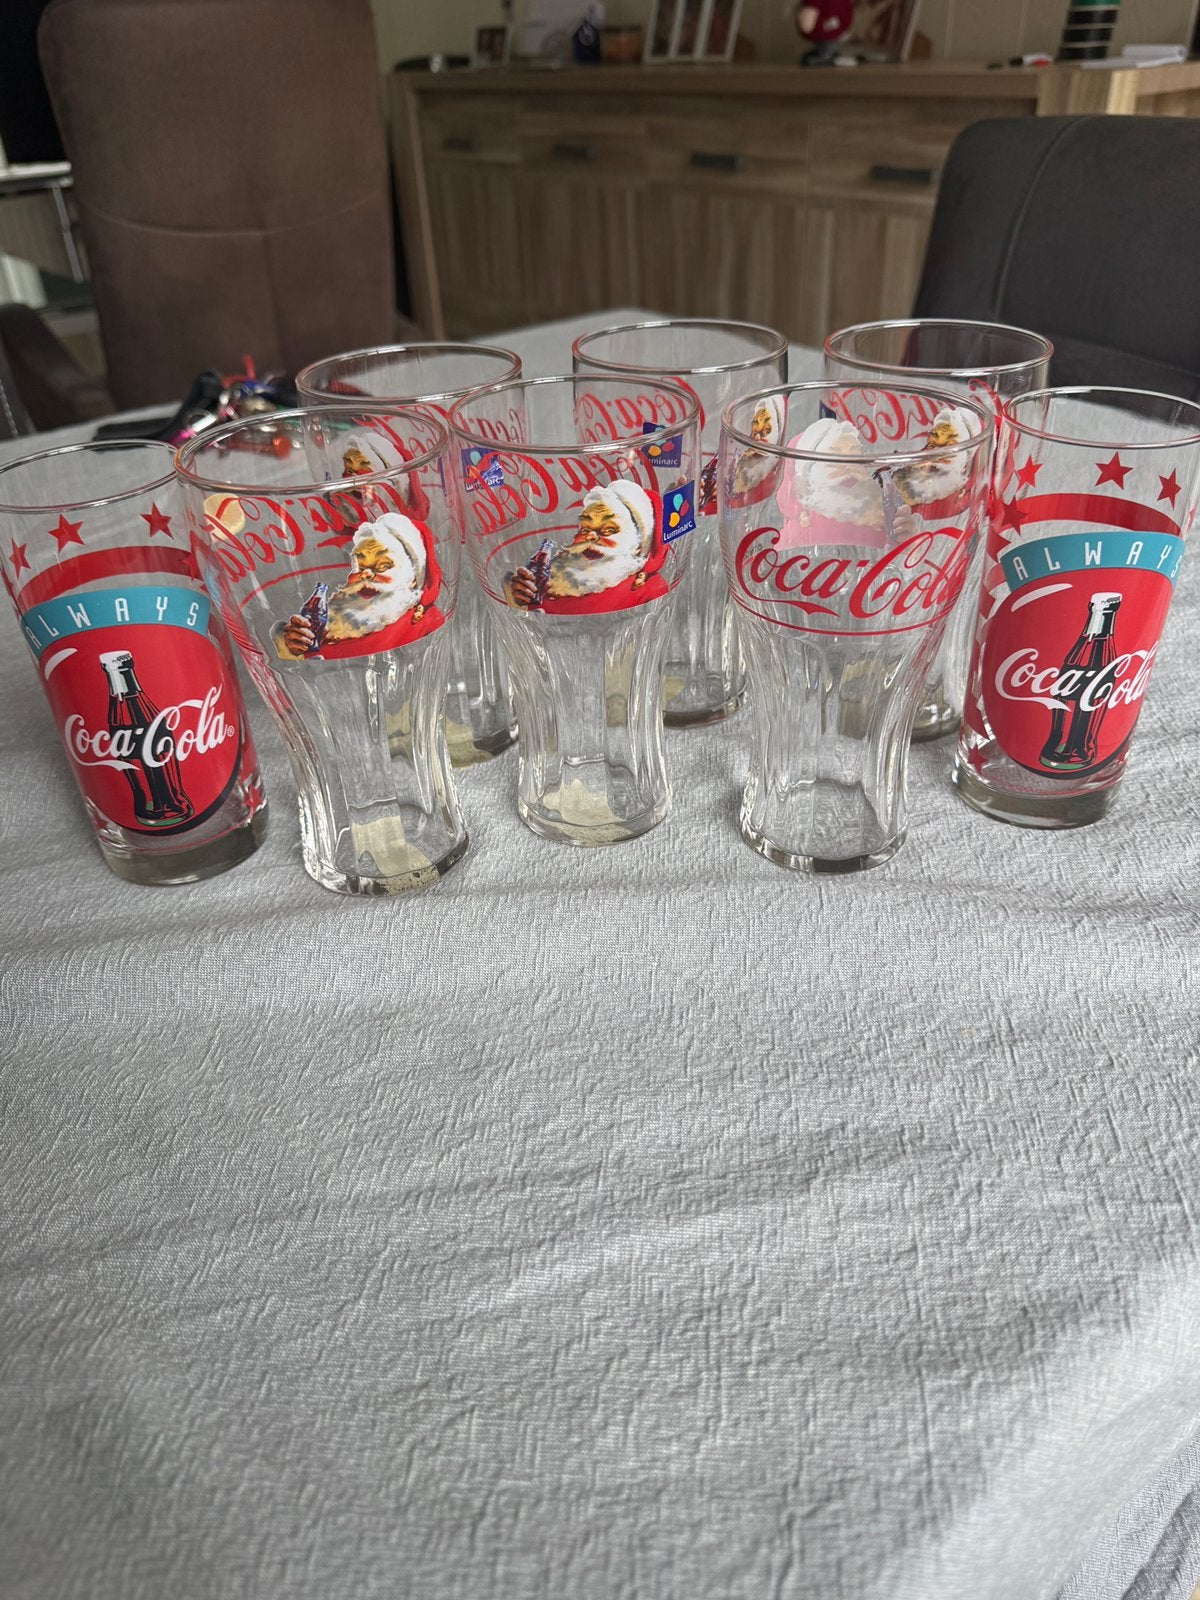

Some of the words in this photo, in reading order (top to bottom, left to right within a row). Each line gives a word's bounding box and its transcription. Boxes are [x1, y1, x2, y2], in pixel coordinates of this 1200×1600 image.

[663, 520, 694, 541] Luminarc
[1013, 541, 1183, 581] ALWAYS
[25, 596, 200, 650] ALWAYS
